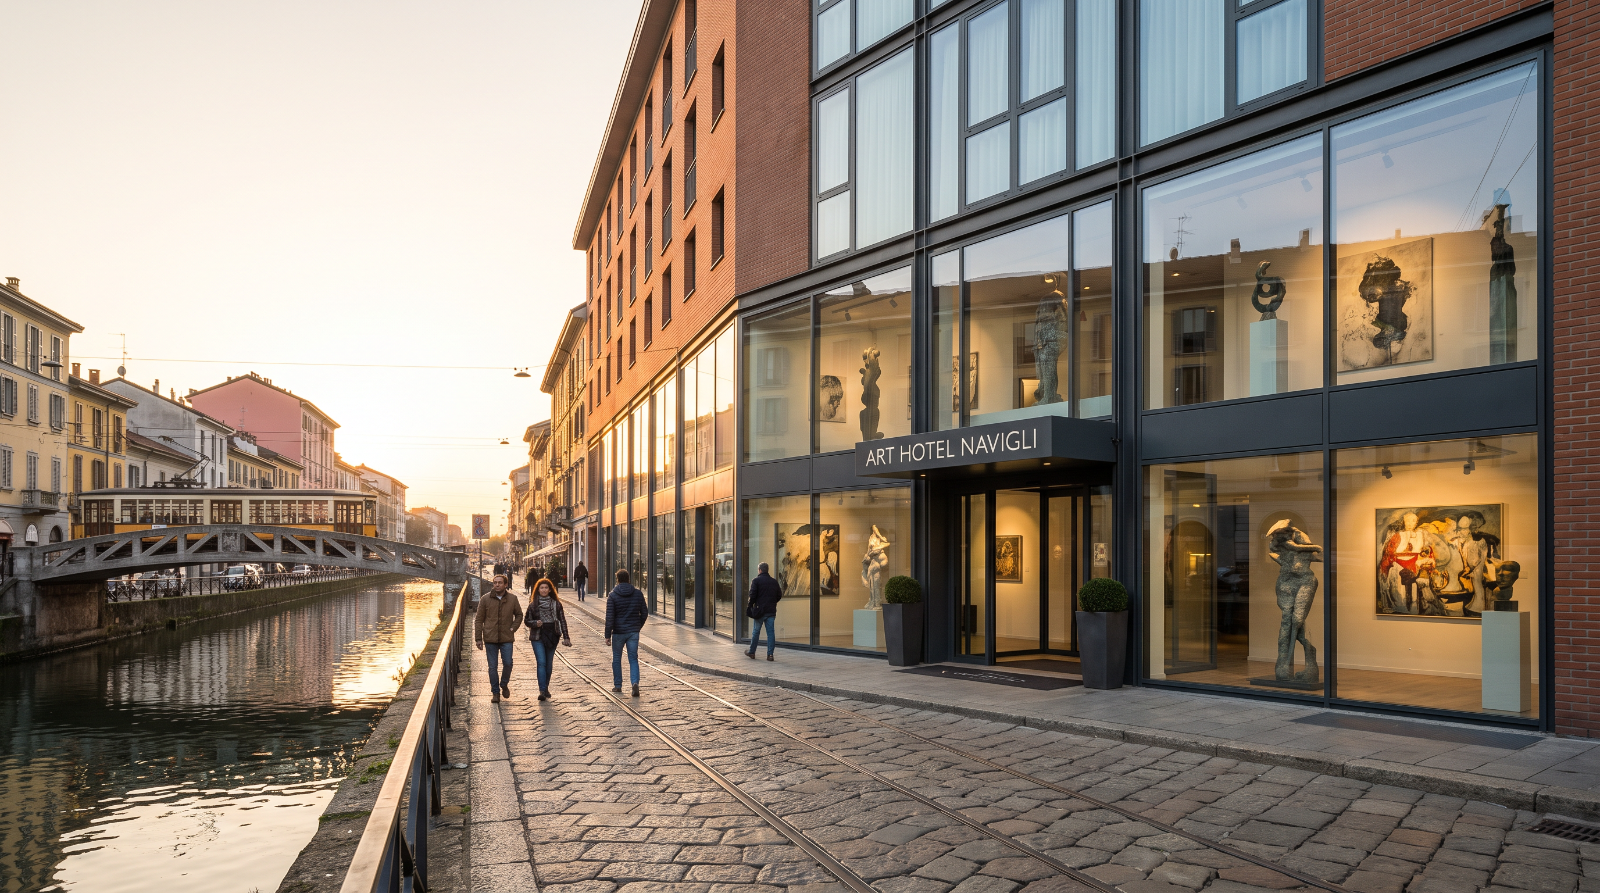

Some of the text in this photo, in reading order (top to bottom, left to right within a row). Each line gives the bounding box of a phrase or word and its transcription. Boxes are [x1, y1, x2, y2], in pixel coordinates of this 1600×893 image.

[865, 428, 1038, 467] ART HOTEL NAVIGLI
